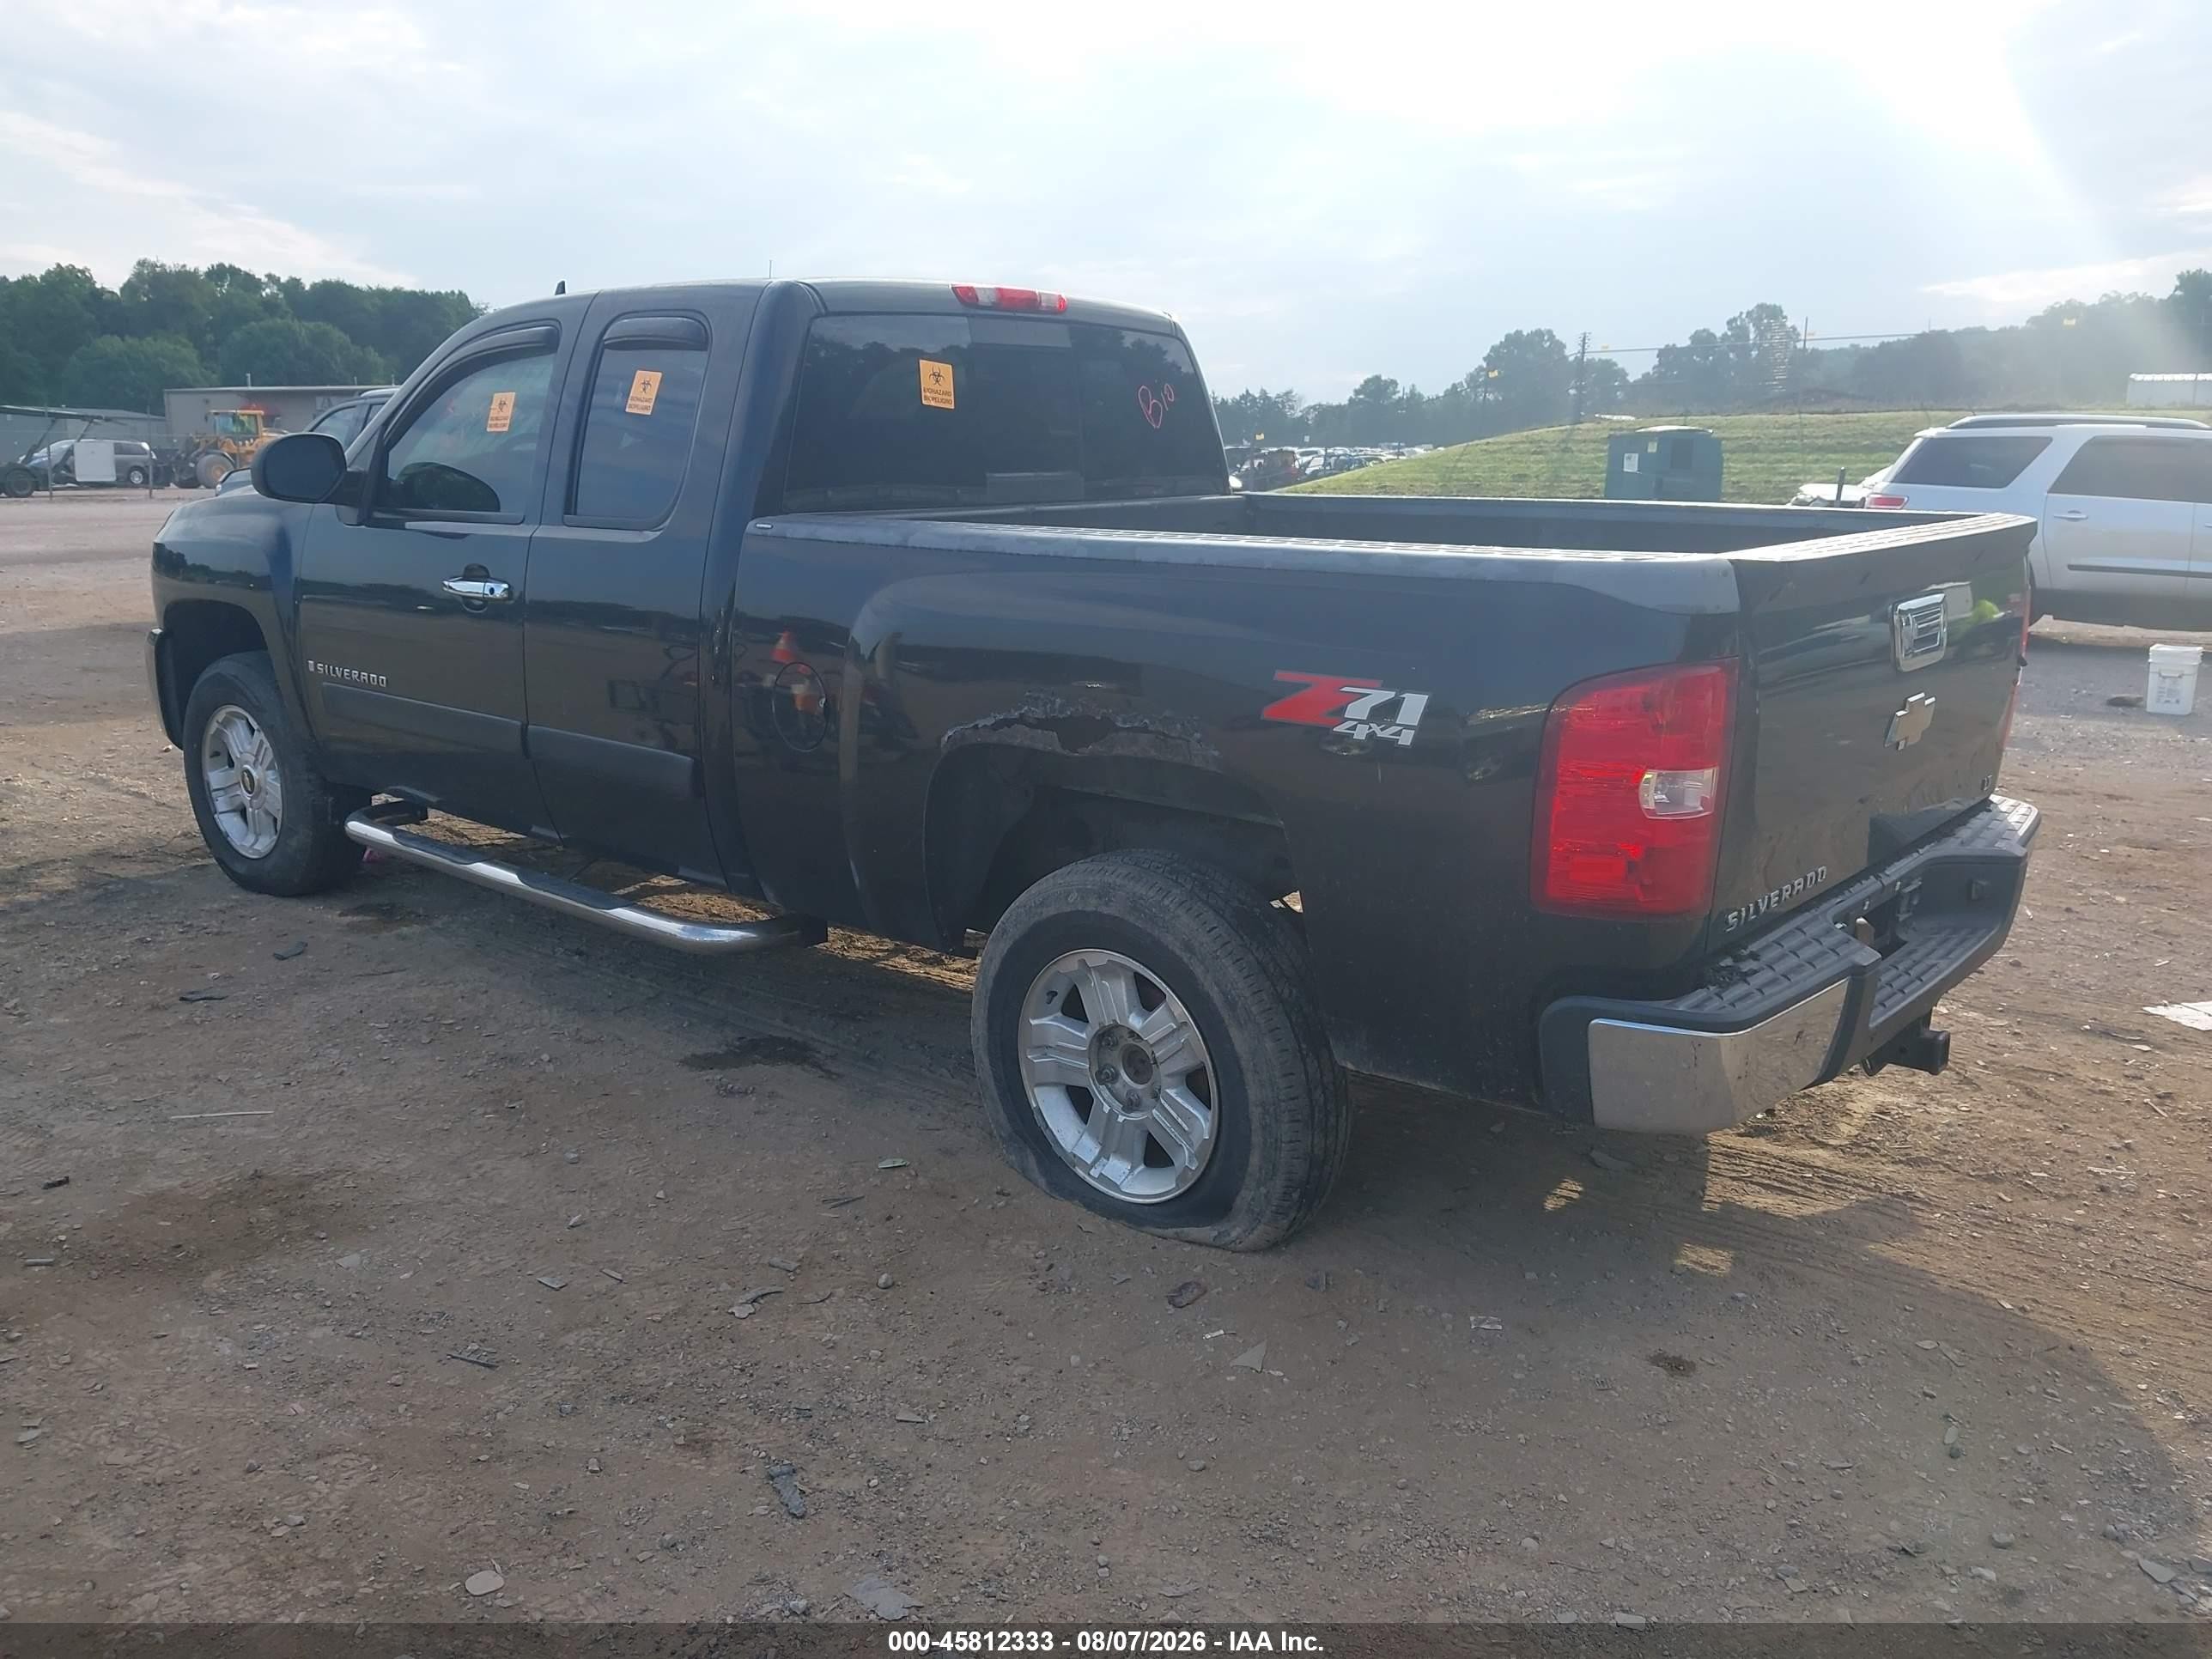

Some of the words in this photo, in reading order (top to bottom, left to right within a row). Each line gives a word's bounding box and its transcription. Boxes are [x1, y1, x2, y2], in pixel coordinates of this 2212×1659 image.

[317, 663, 386, 688] SILVERADO
[1262, 670, 1430, 727] Z71
[1725, 866, 1827, 933] SILVERADO
